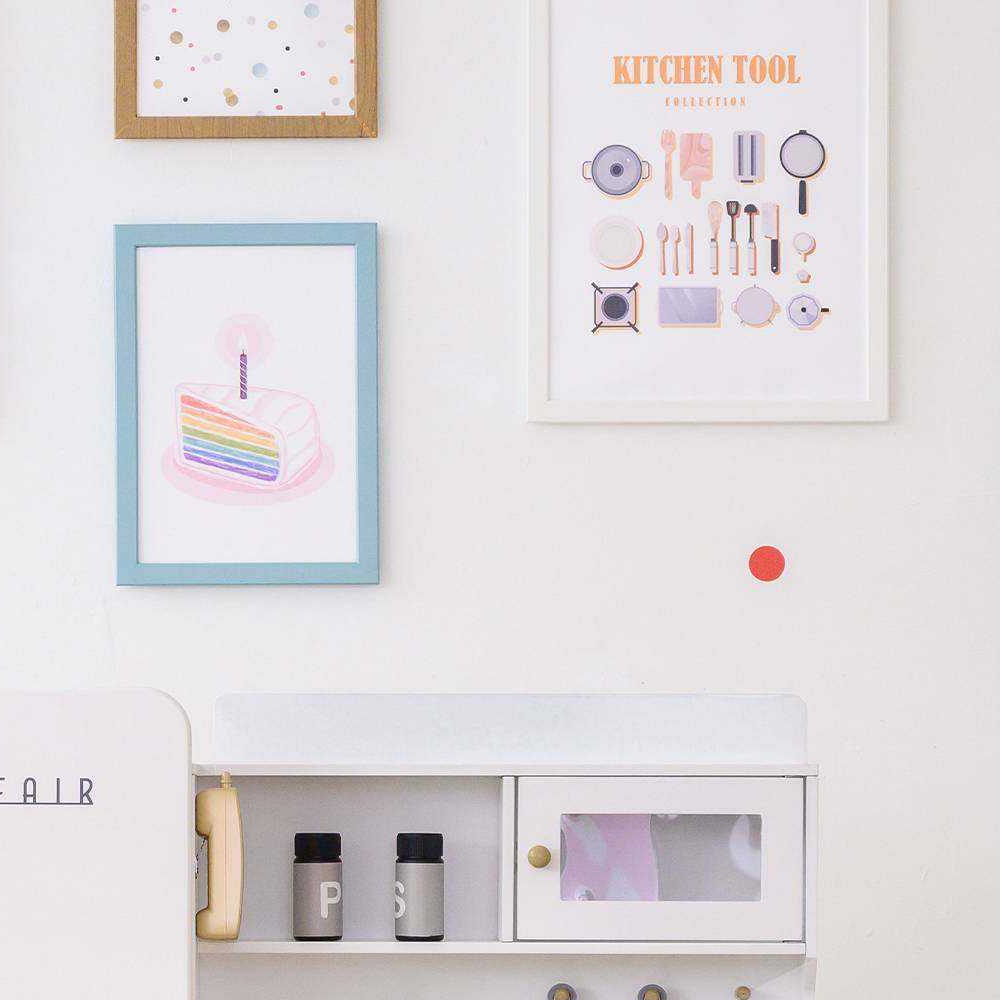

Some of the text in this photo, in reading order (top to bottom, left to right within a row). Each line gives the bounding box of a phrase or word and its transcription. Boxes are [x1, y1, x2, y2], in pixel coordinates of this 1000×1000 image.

[613, 55, 801, 84] KITCHEN TOOL
[665, 96, 746, 107] COLLECTION
[320, 881, 341, 919] P
[395, 881, 406, 919] S
